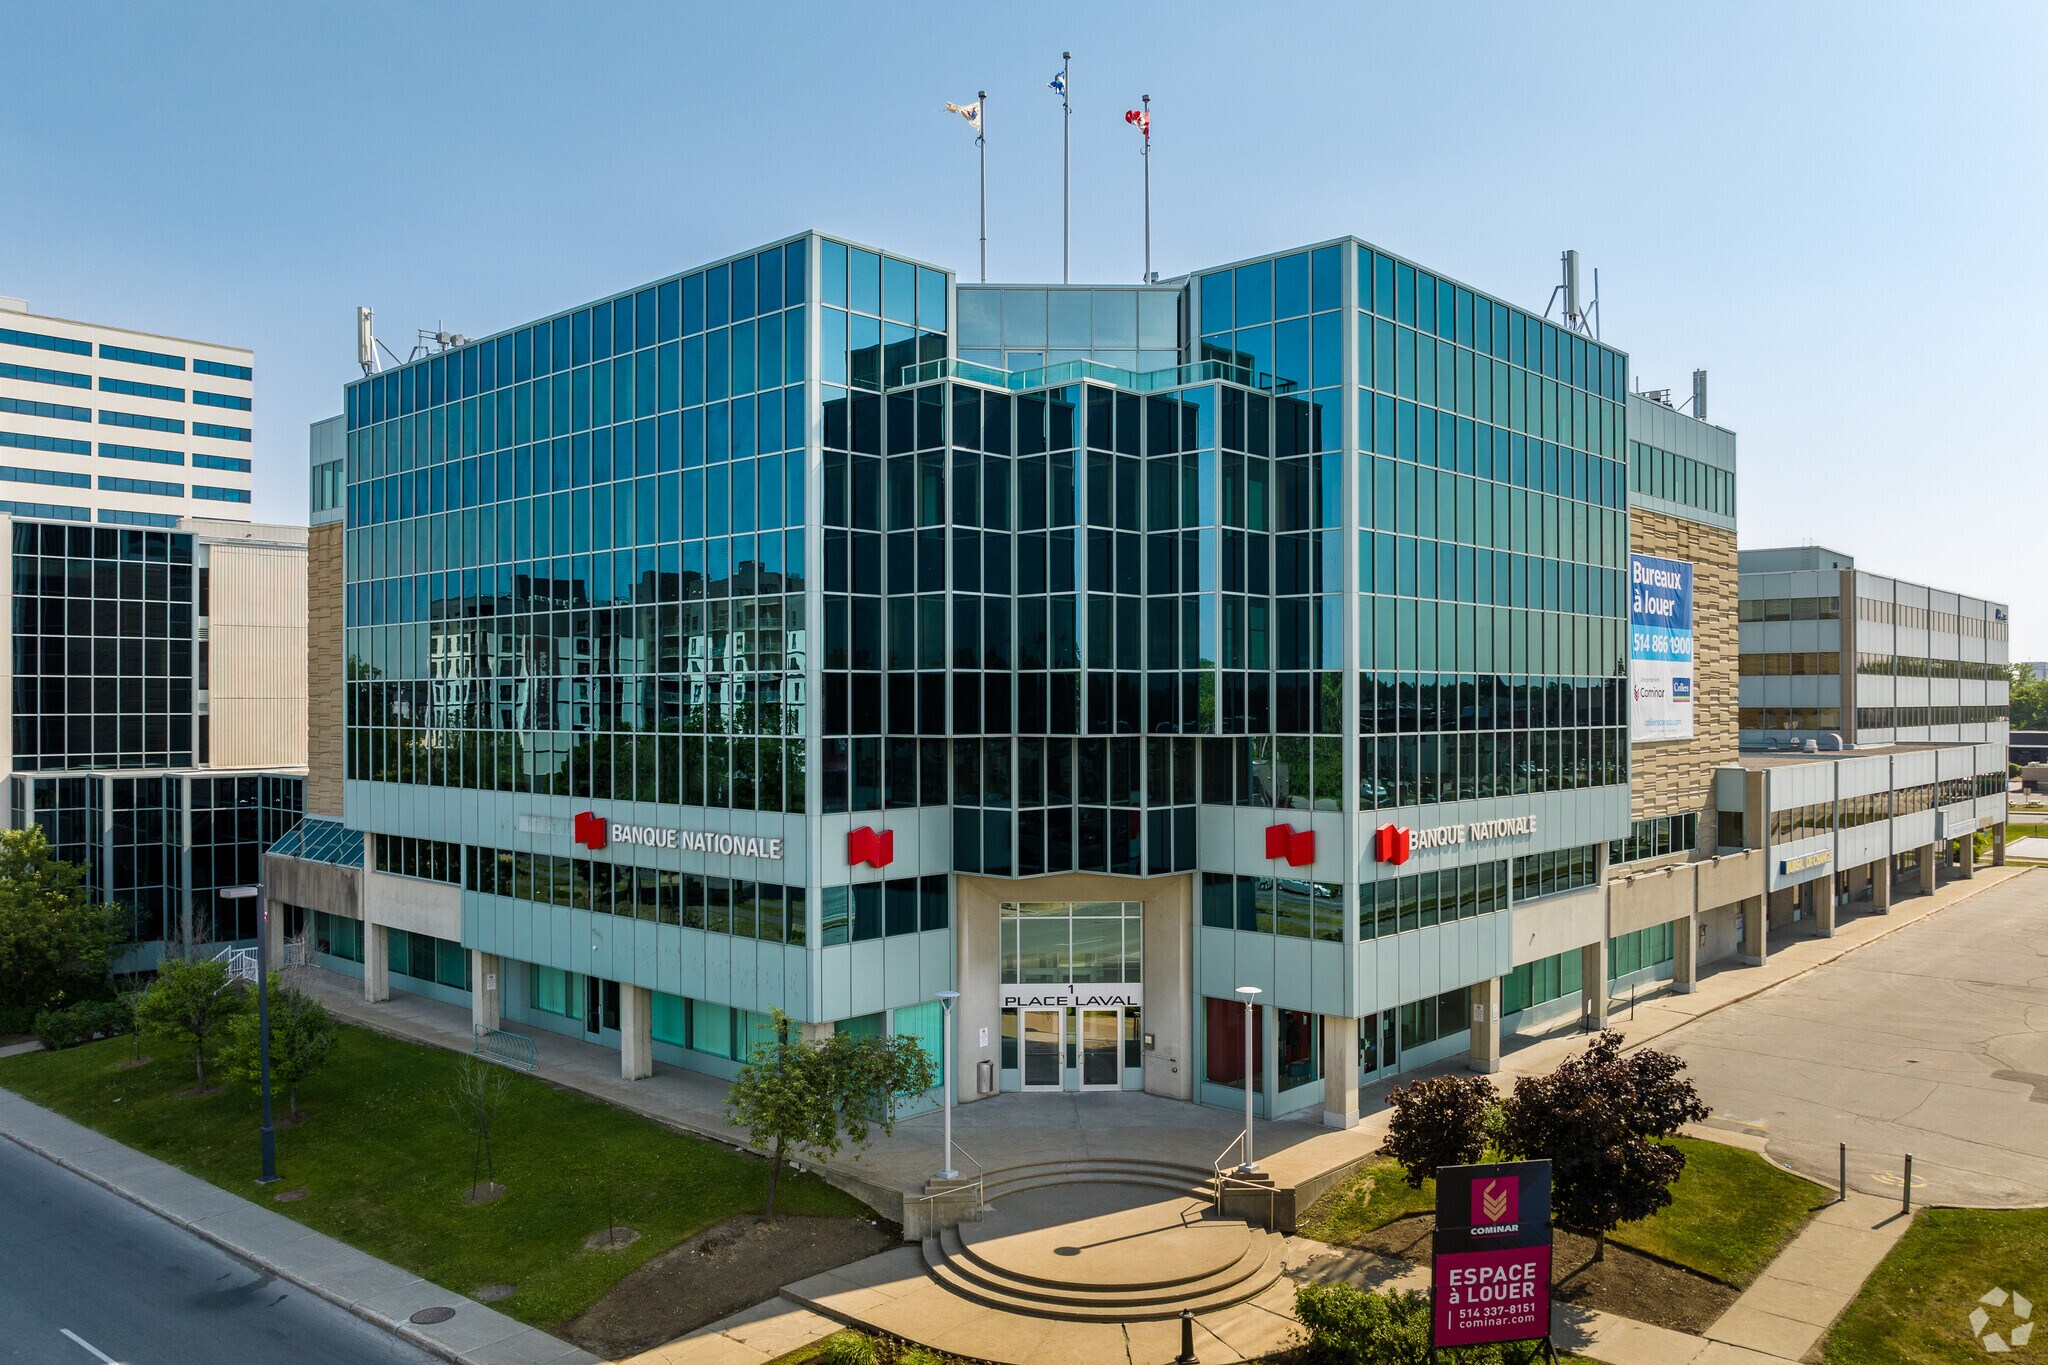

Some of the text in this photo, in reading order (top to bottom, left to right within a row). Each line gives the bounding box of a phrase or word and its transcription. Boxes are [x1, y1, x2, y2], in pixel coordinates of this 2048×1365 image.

[1633, 561, 1682, 590] Bureaux
[1633, 589, 1675, 617] à louer
[1634, 633, 1691, 655] 514 866 1900
[1640, 687, 1665, 698] Cominar
[612, 824, 783, 860] BANQUE NATIONALE
[1409, 815, 1537, 851] BANQUE NATIONALE
[1806, 855, 1813, 868] DE
[1068, 984, 1074, 994] 1
[1005, 995, 1138, 1006] PLACE LAVAL
[1470, 1224, 1519, 1236] COMINAR
[1449, 1262, 1537, 1287] ESPACE
[1449, 1281, 1535, 1305] à LOUER
[1459, 1302, 1536, 1319] 514 337-8151
[1459, 1313, 1535, 1329] cominar.com
